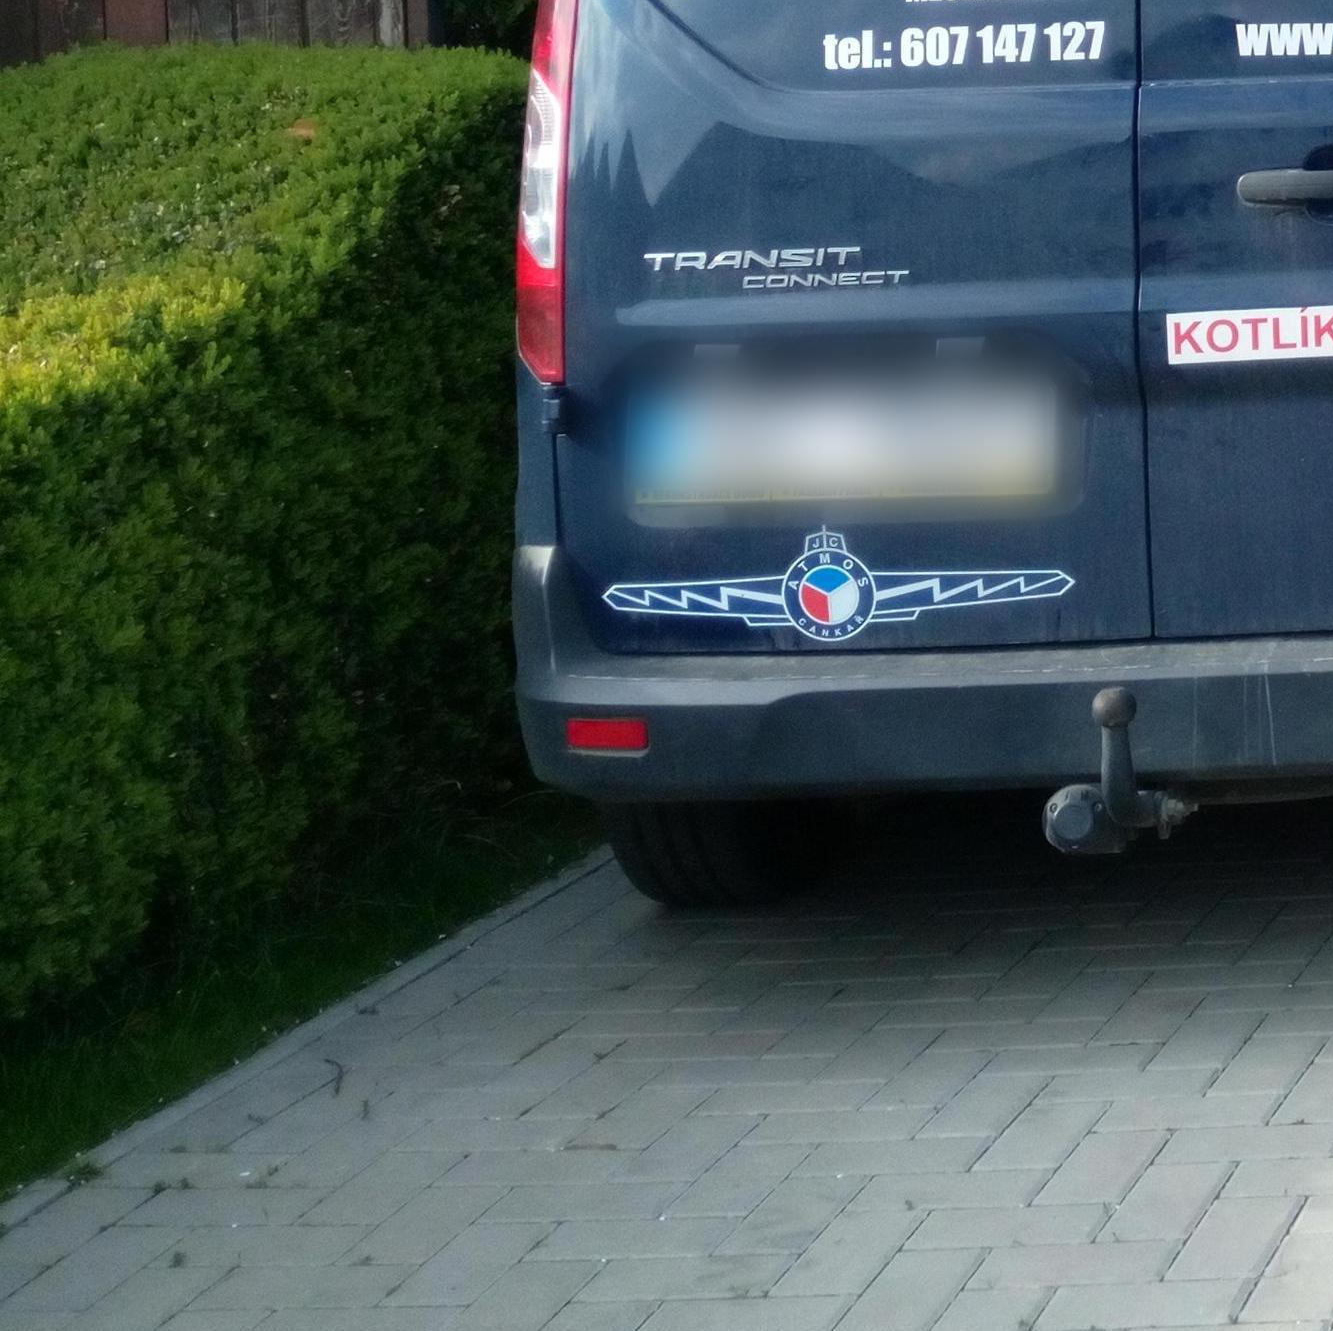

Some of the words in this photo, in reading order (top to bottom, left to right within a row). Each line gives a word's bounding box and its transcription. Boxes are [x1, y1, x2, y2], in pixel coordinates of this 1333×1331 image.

[823, 30, 892, 71] tel.:
[900, 25, 970, 67] 607
[977, 23, 1036, 64] 147
[1043, 20, 1105, 62] 127
[644, 246, 861, 271] TRANSIT
[742, 270, 909, 290] CONNECT
[788, 553, 869, 590] ATMOS
